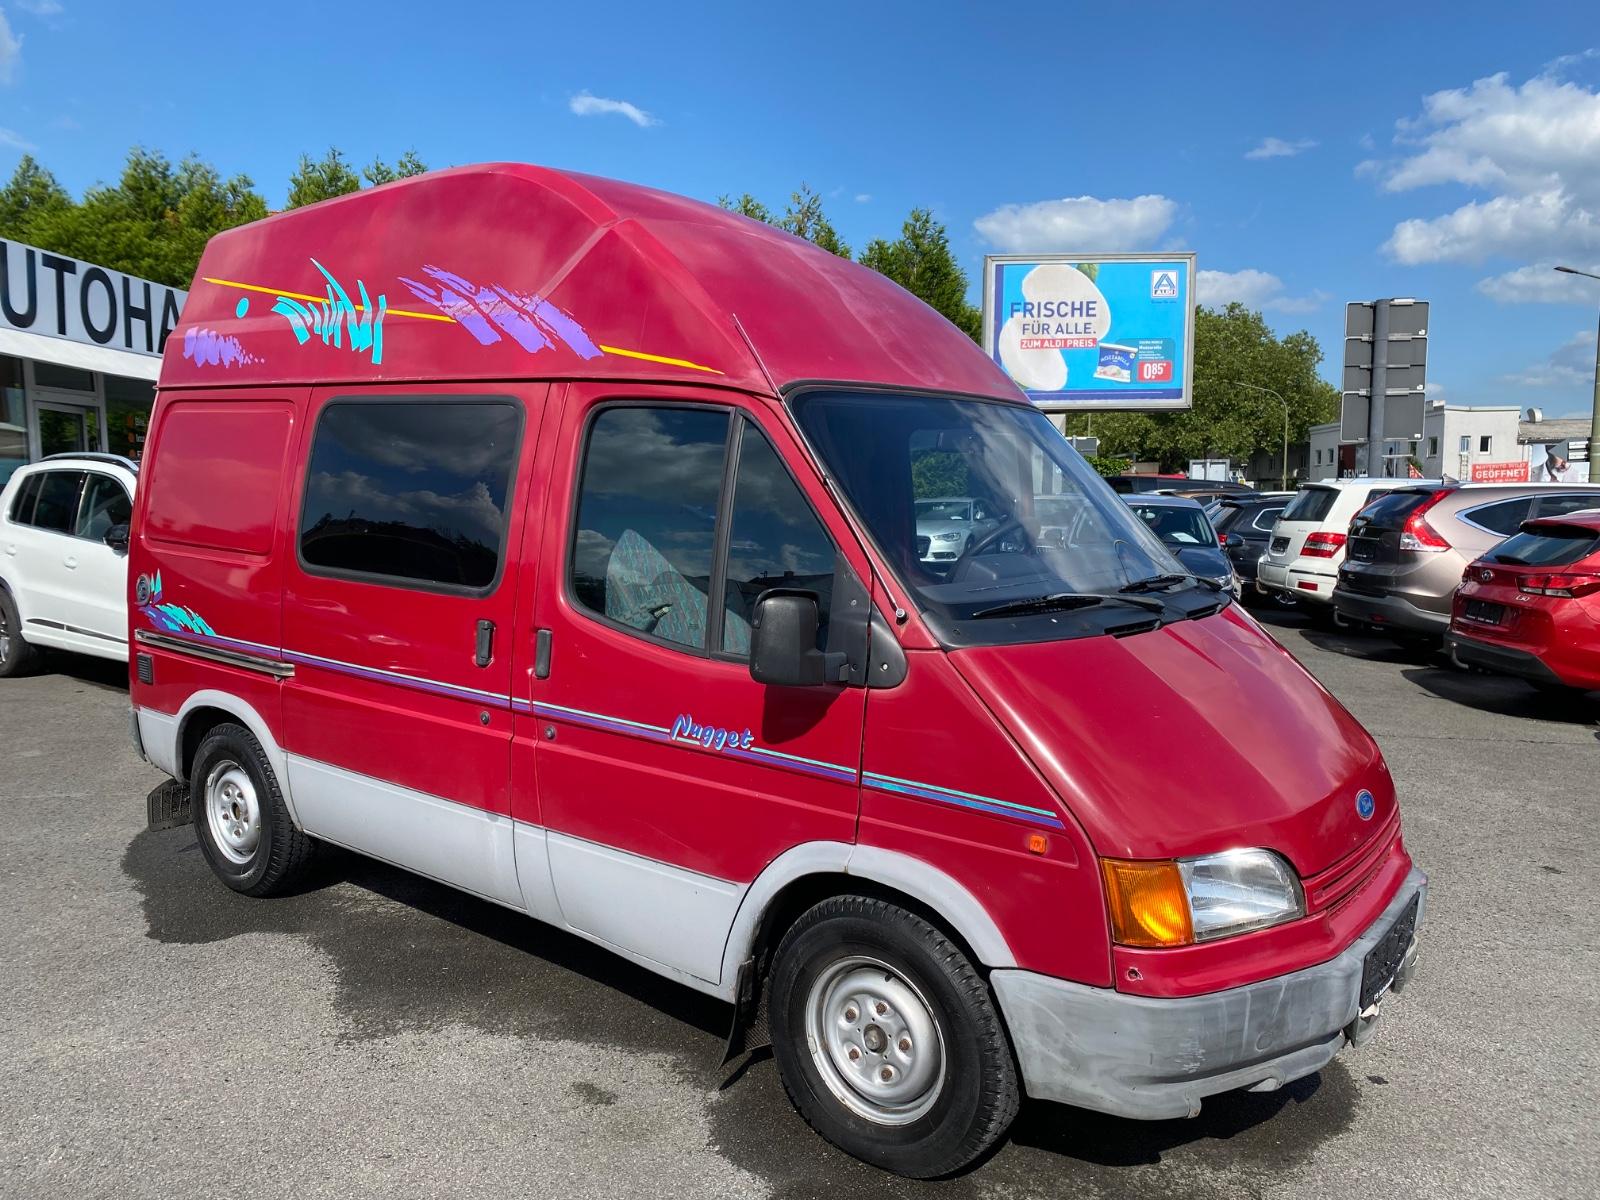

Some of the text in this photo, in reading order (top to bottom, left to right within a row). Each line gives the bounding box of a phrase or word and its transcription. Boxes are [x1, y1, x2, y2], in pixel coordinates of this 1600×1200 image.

[1010, 300, 1097, 318] FRISCHE
[1022, 320, 1096, 335] FÜR ALLE.
[1021, 338, 1096, 348] ZUM ALDI PREIS.
[671, 713, 754, 750] Nugget
